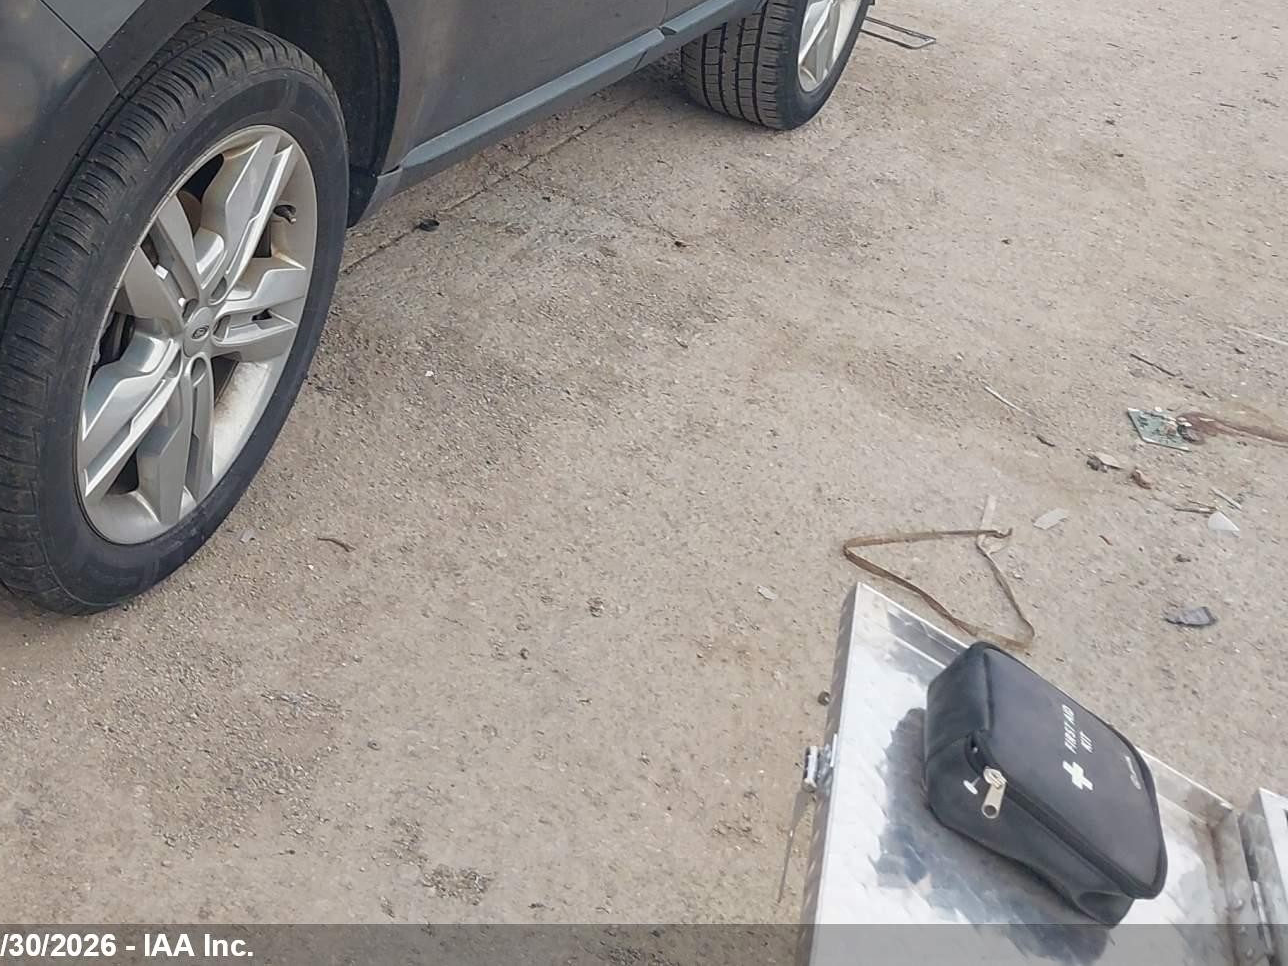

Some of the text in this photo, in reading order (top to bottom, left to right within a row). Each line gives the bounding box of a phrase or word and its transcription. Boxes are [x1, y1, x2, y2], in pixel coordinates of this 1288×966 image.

[1061, 704, 1077, 754] FIRST AID
[1079, 731, 1093, 753] KIT
